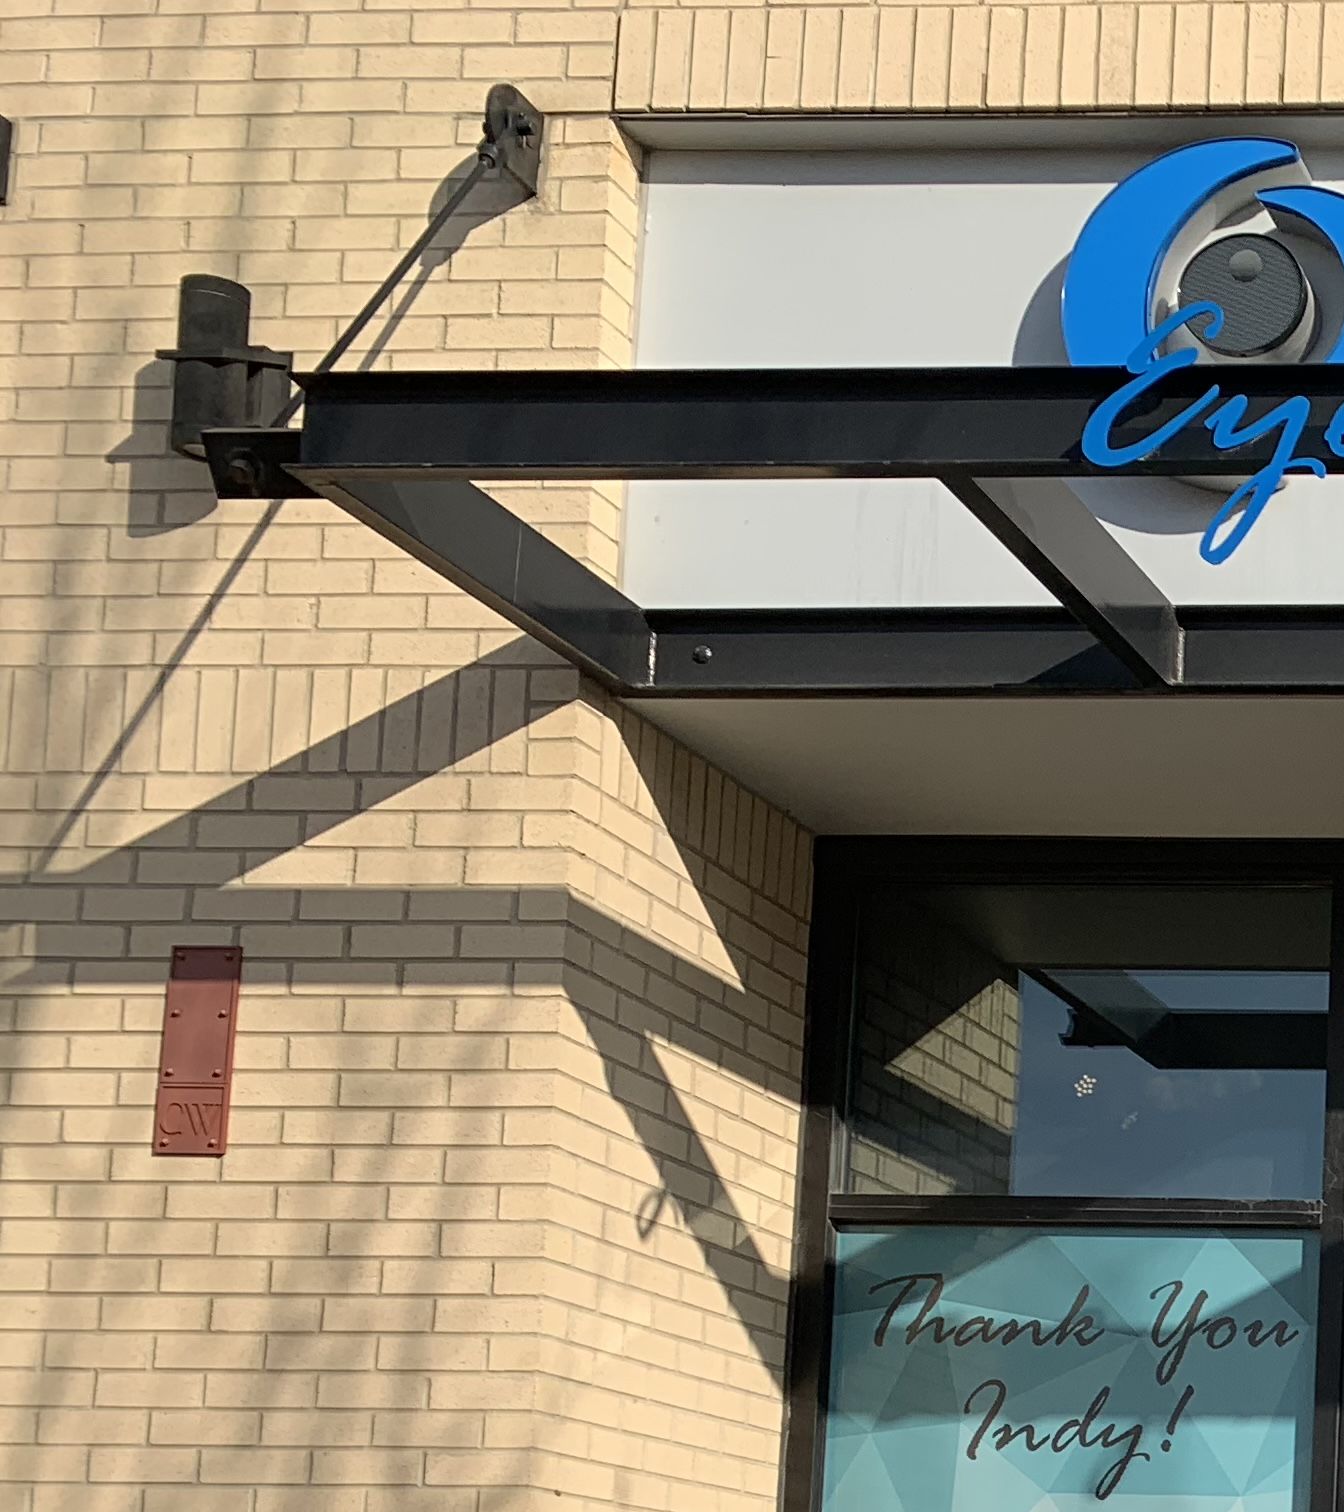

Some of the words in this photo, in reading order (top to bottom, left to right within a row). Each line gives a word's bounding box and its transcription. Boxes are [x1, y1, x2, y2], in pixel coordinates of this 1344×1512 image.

[869, 1273, 1104, 1347] Thank
[1150, 1280, 1299, 1385] You
[963, 1380, 1194, 1500] Indy!
